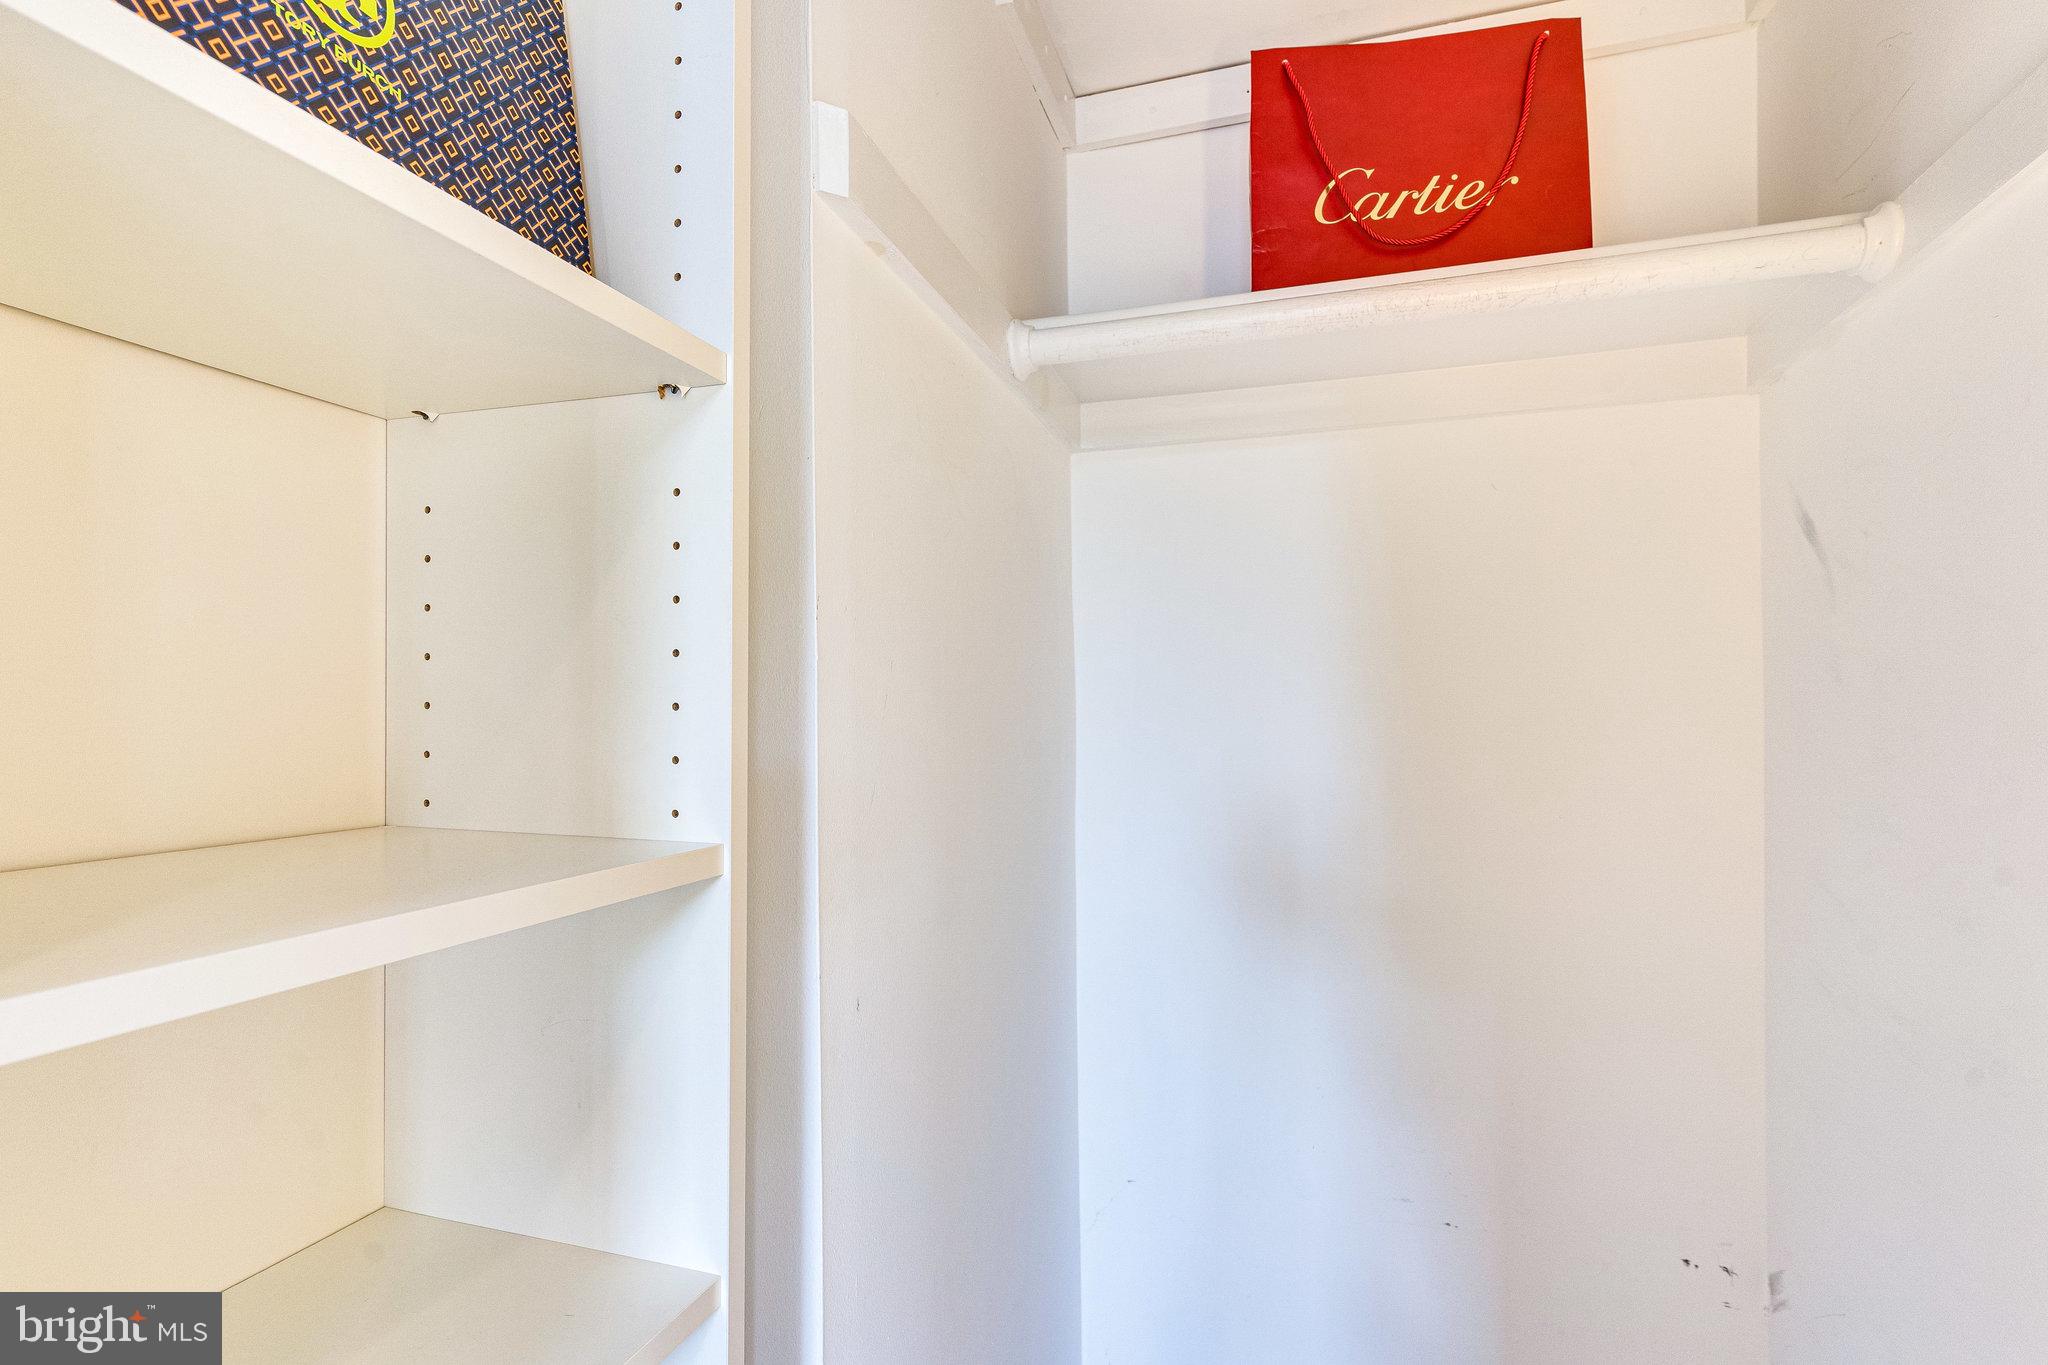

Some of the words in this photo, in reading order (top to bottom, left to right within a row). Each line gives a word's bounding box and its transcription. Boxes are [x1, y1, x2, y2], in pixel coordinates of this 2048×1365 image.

[270, 0, 330, 49] TORY
[334, 43, 402, 102] BURCH
[1313, 167, 1520, 225] Cartier
